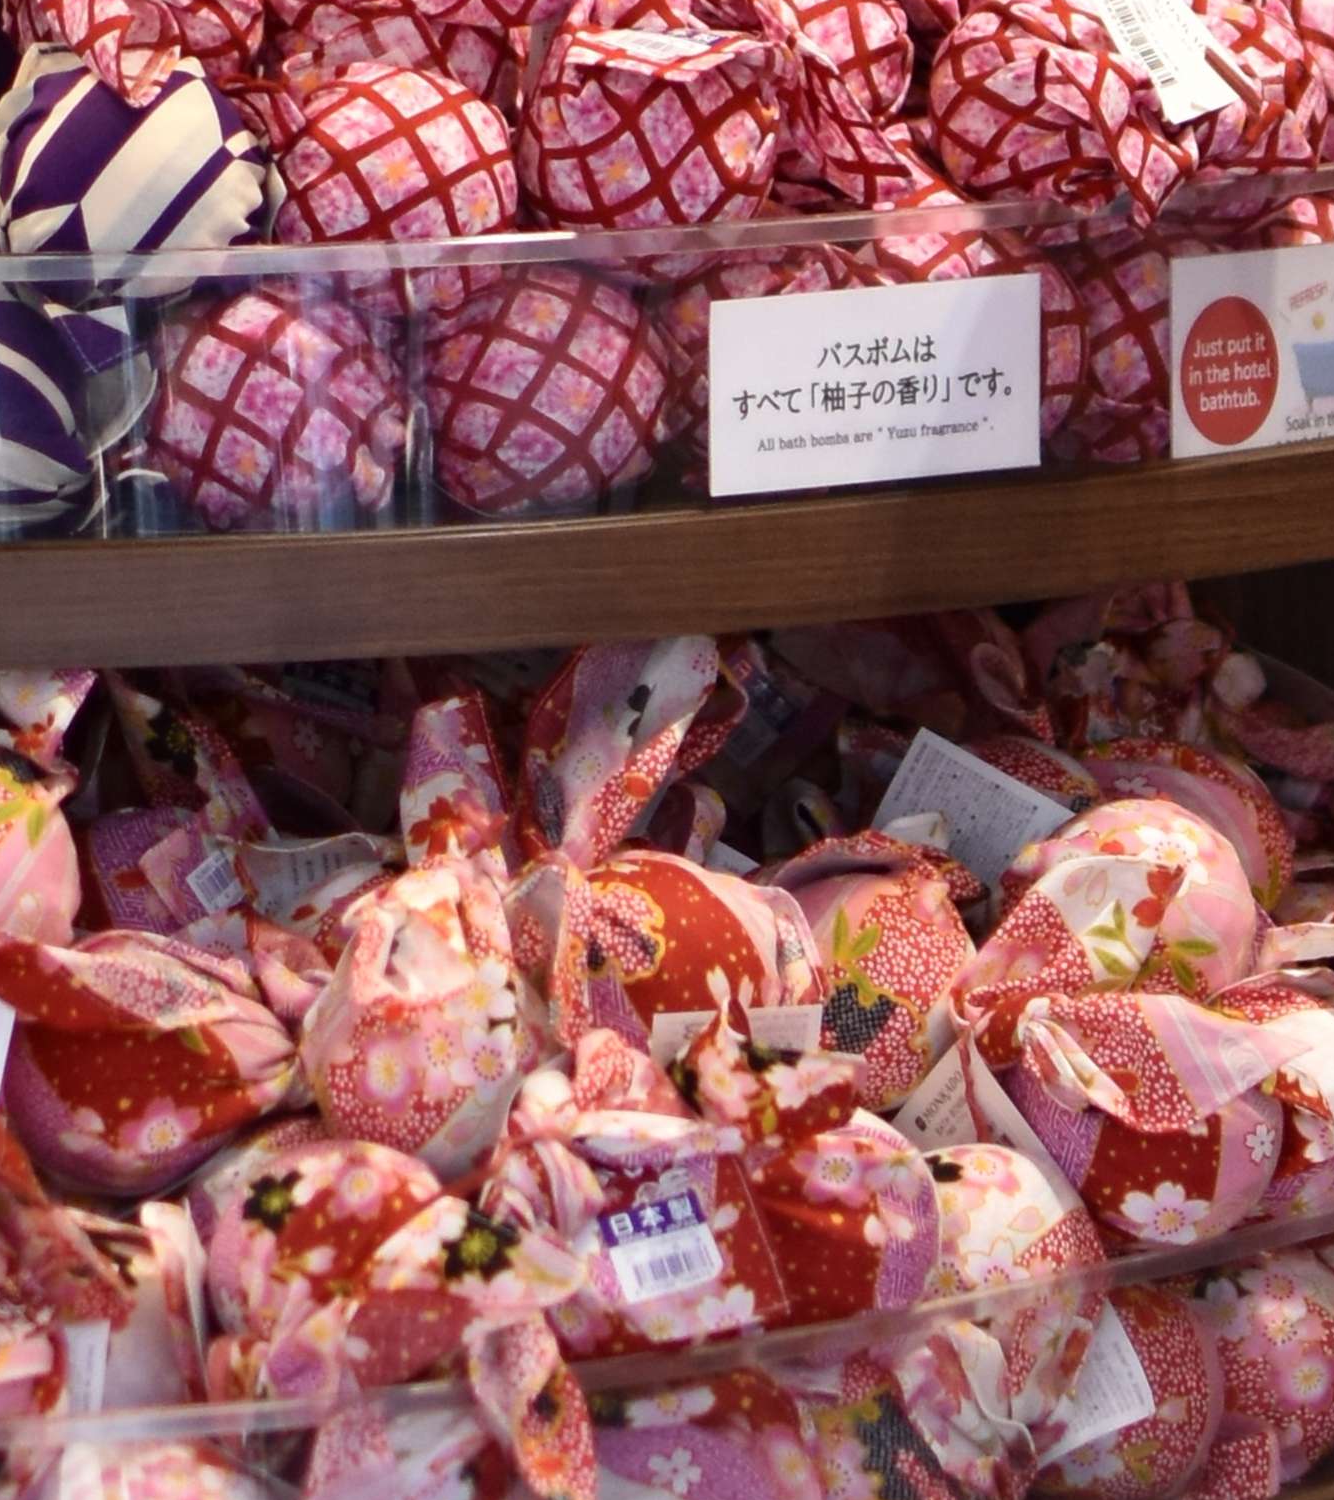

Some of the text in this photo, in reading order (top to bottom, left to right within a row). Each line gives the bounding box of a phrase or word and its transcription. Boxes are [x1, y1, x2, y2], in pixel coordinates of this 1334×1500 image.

[816, 334, 938, 368] バスボムは
[1192, 331, 1267, 359] Just put it
[1188, 358, 1272, 385] in the hotel
[731, 367, 1013, 420] すべて「柚子の香り」です。
[1199, 386, 1261, 413] bathtub.
[757, 420, 979, 452] All bath bombs are Yuzu fragrance
[1285, 413, 1311, 433] Soak
[1314, 415, 1325, 429] in
[920, 1068, 964, 1125] MONKADO
[610, 1196, 691, 1234] 日本製
